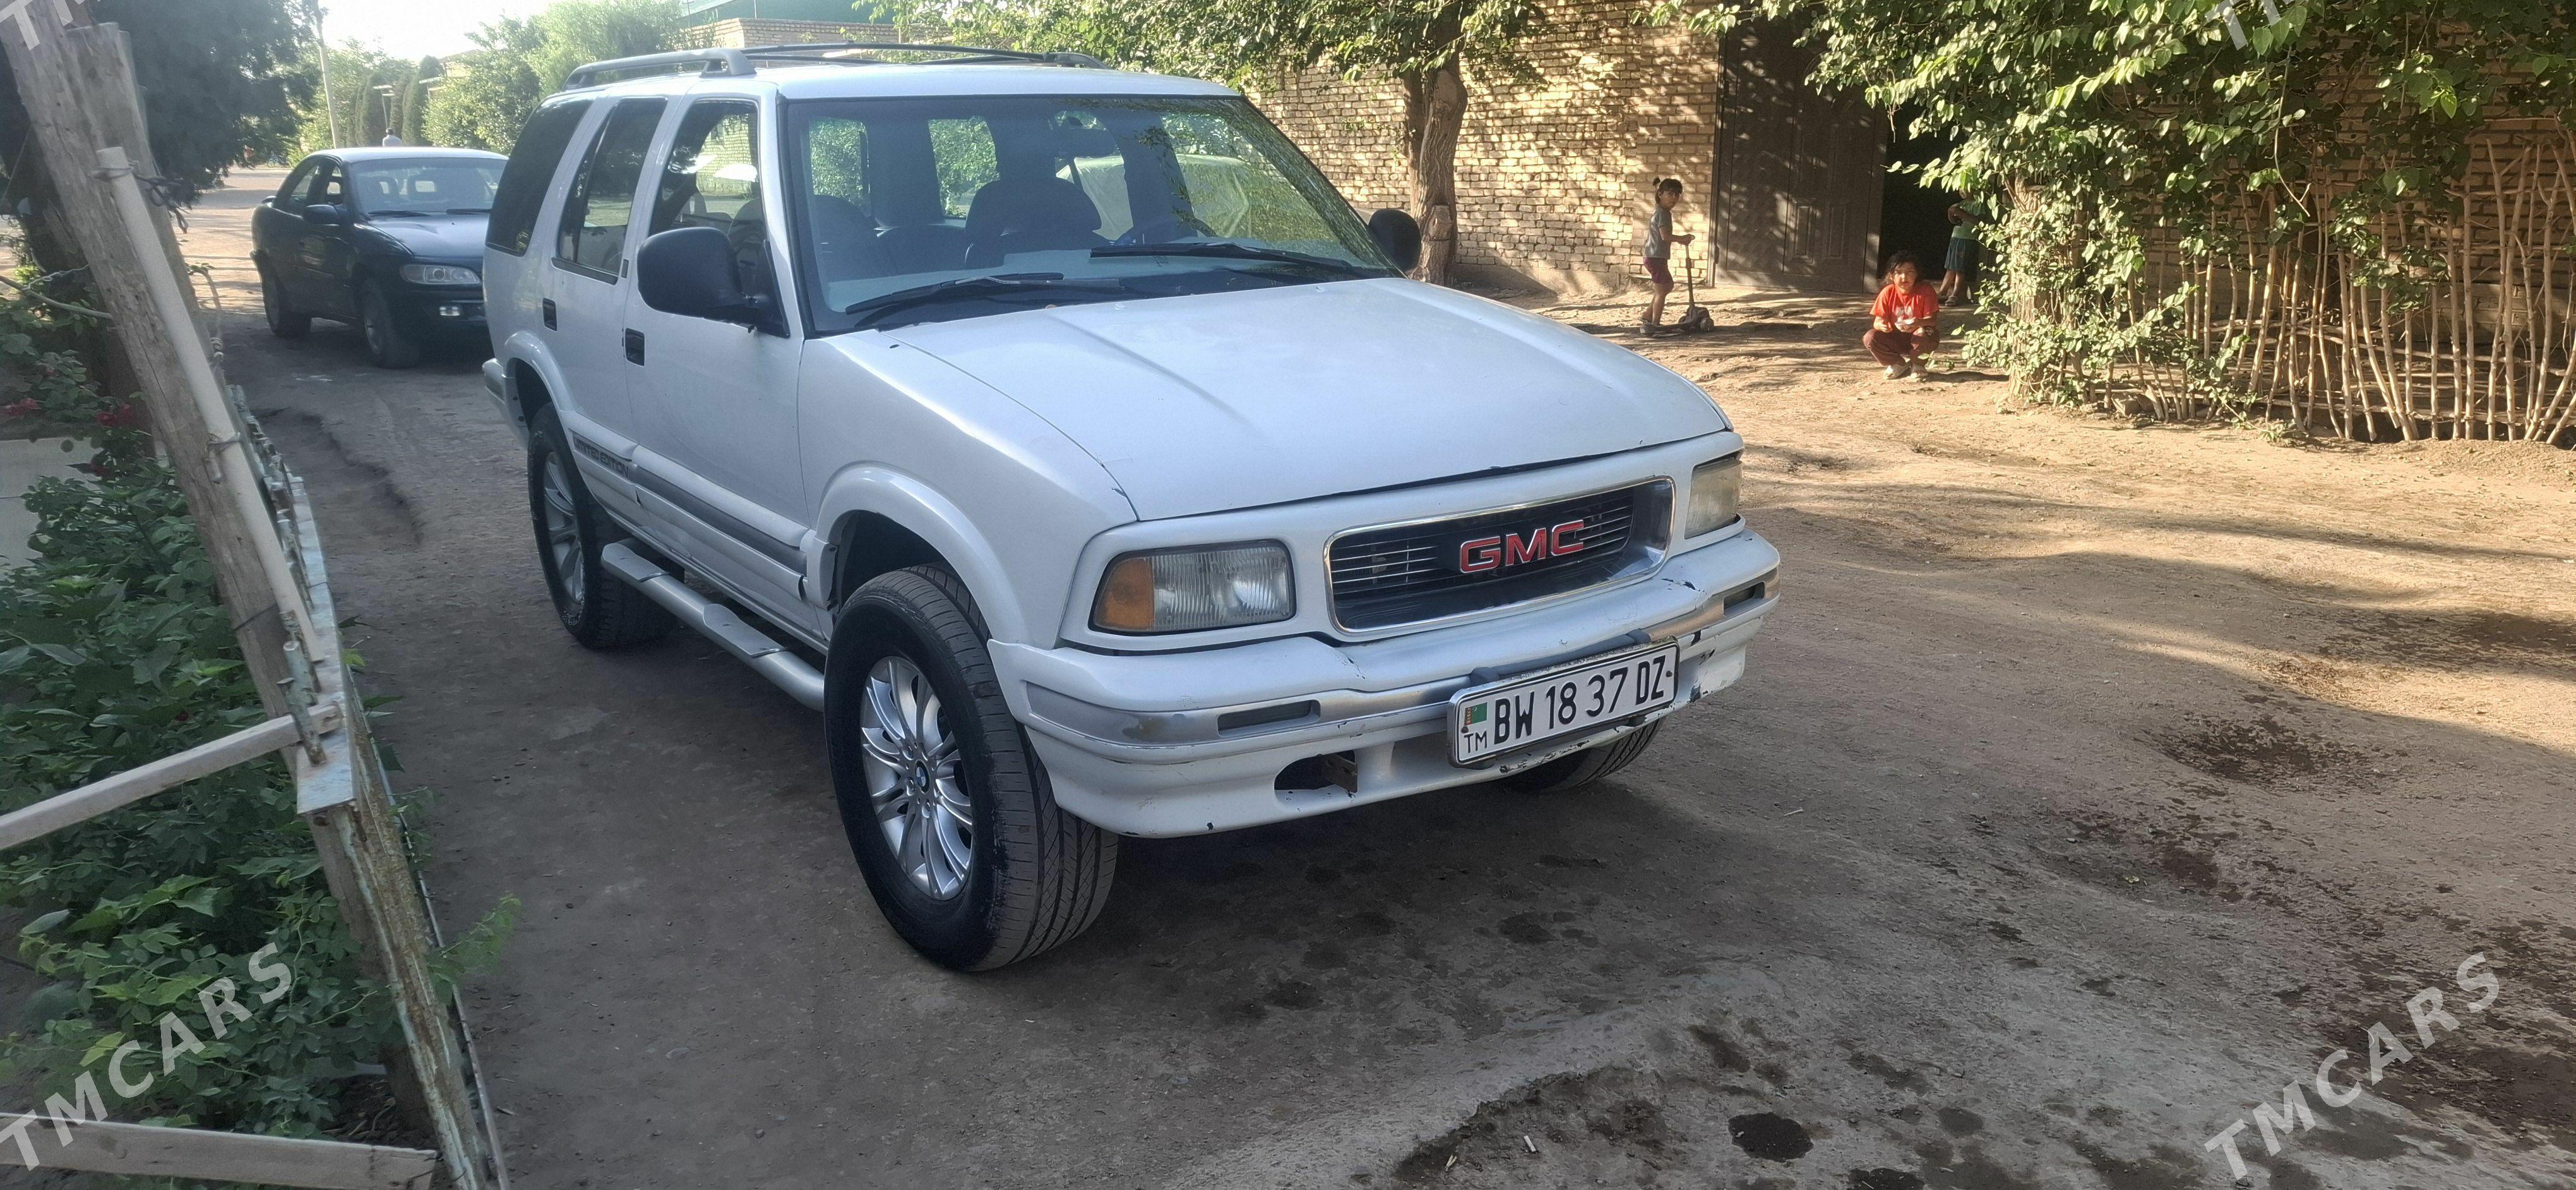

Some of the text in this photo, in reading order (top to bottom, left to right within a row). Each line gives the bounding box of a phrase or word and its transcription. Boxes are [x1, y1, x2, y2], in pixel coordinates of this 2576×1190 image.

[1460, 520, 1584, 573] GMC
[1494, 655, 1666, 745] BW 18 37 DZ
[1464, 731, 1488, 753] TM
